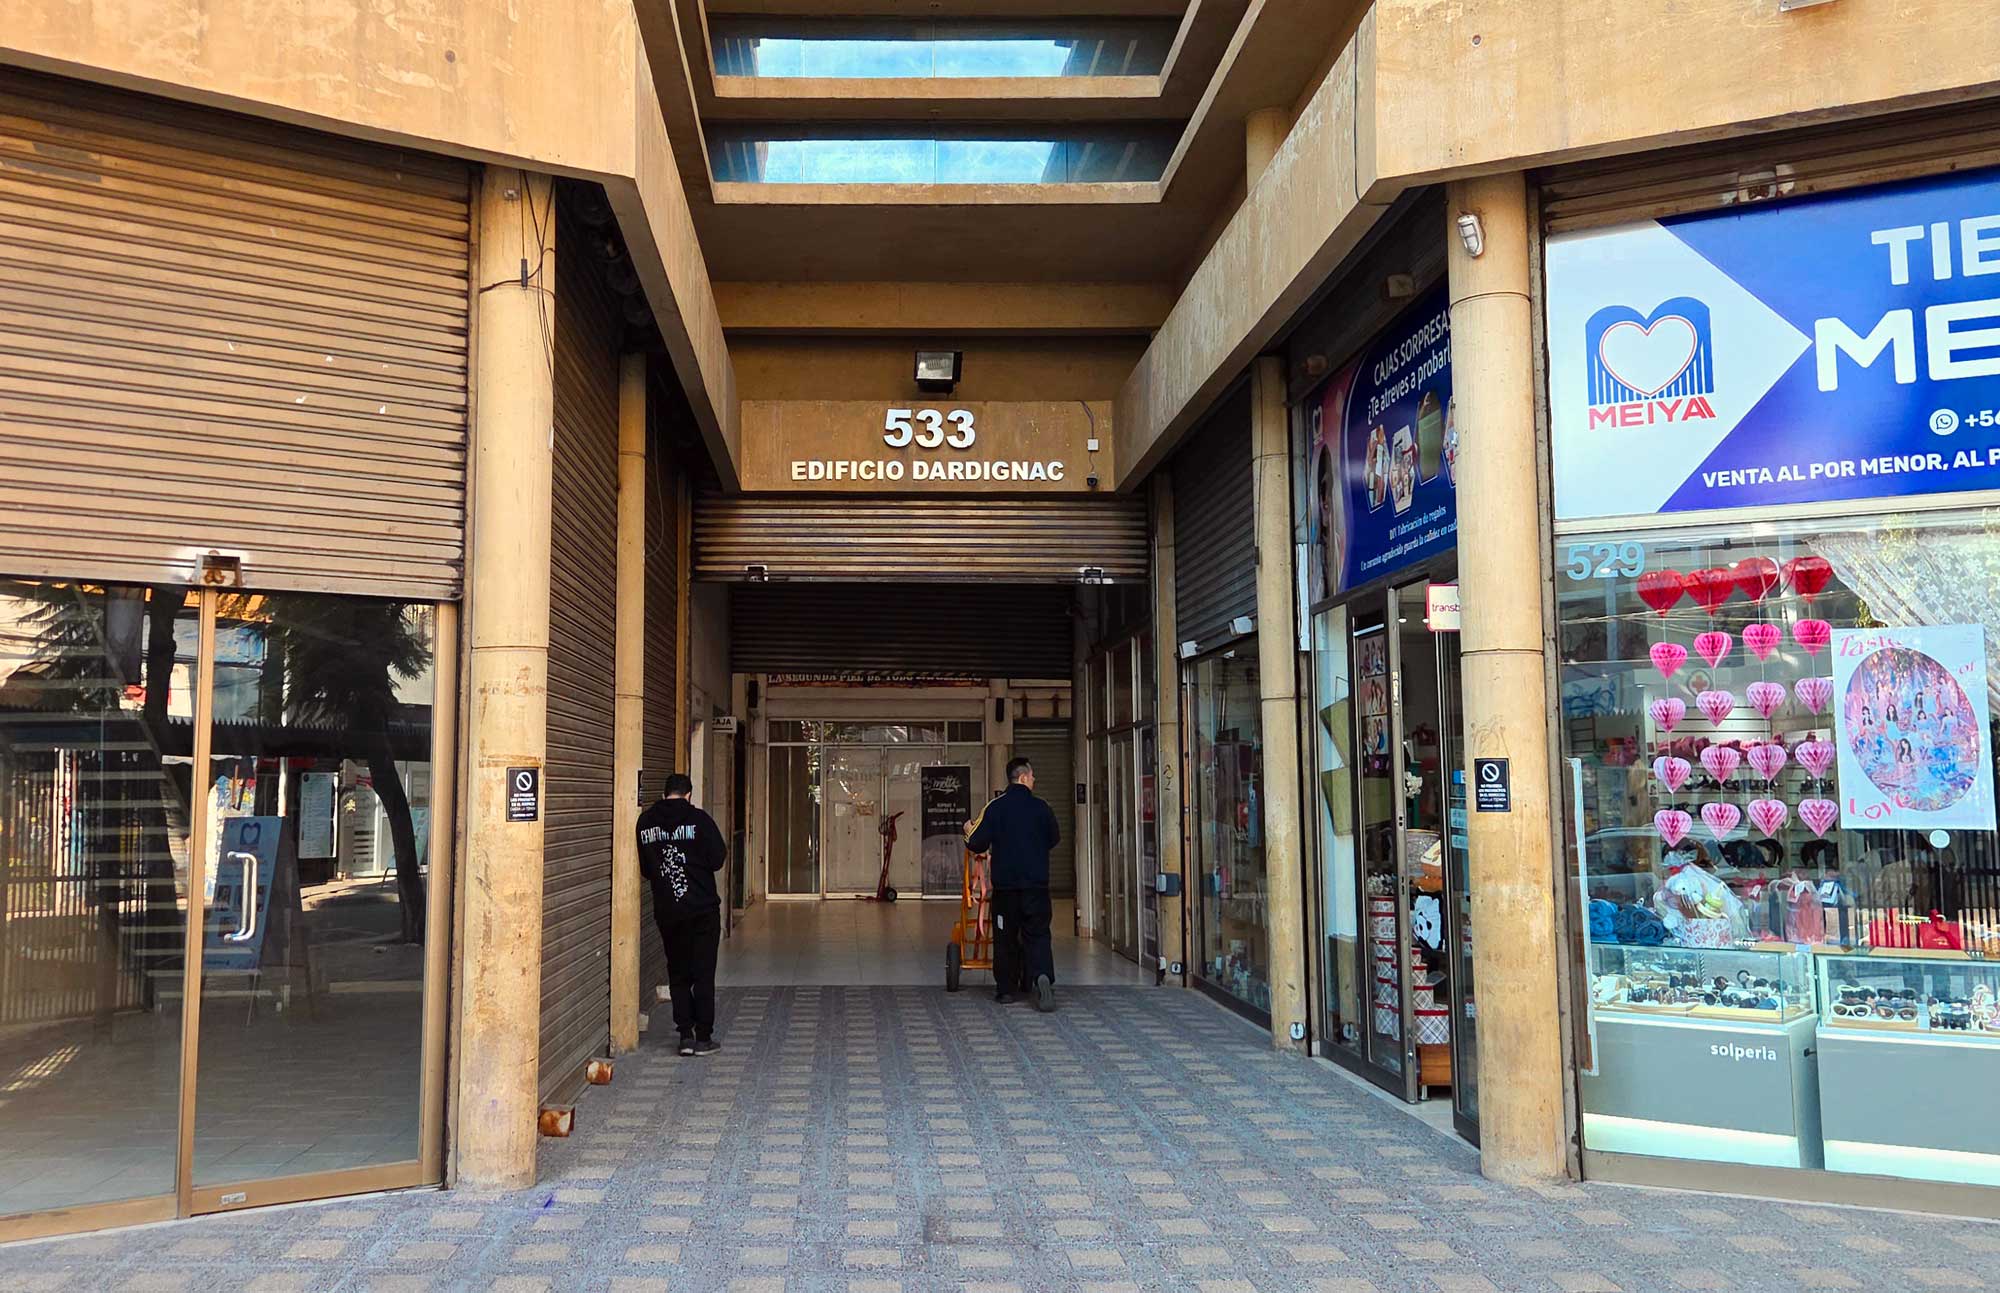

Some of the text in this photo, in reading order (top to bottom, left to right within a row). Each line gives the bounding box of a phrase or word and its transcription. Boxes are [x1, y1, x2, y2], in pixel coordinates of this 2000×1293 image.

[1814, 298, 2000, 392] ME
[1374, 348, 1399, 386] CAJAS
[1367, 396, 1380, 425] ¿Te
[1380, 375, 1409, 411] atreves
[1410, 371, 1417, 390] a
[1589, 396, 1716, 430] MEIYA
[883, 408, 976, 449] 533
[791, 460, 1064, 481] EDIFICIO DARDIGNAC
[1702, 467, 1774, 489] VENTA
[1776, 464, 1806, 483] AL
[1809, 460, 1856, 480] POR
[1860, 452, 1949, 476] MENOR,
[1953, 449, 1985, 469] AL
[1566, 541, 1645, 581] 529
